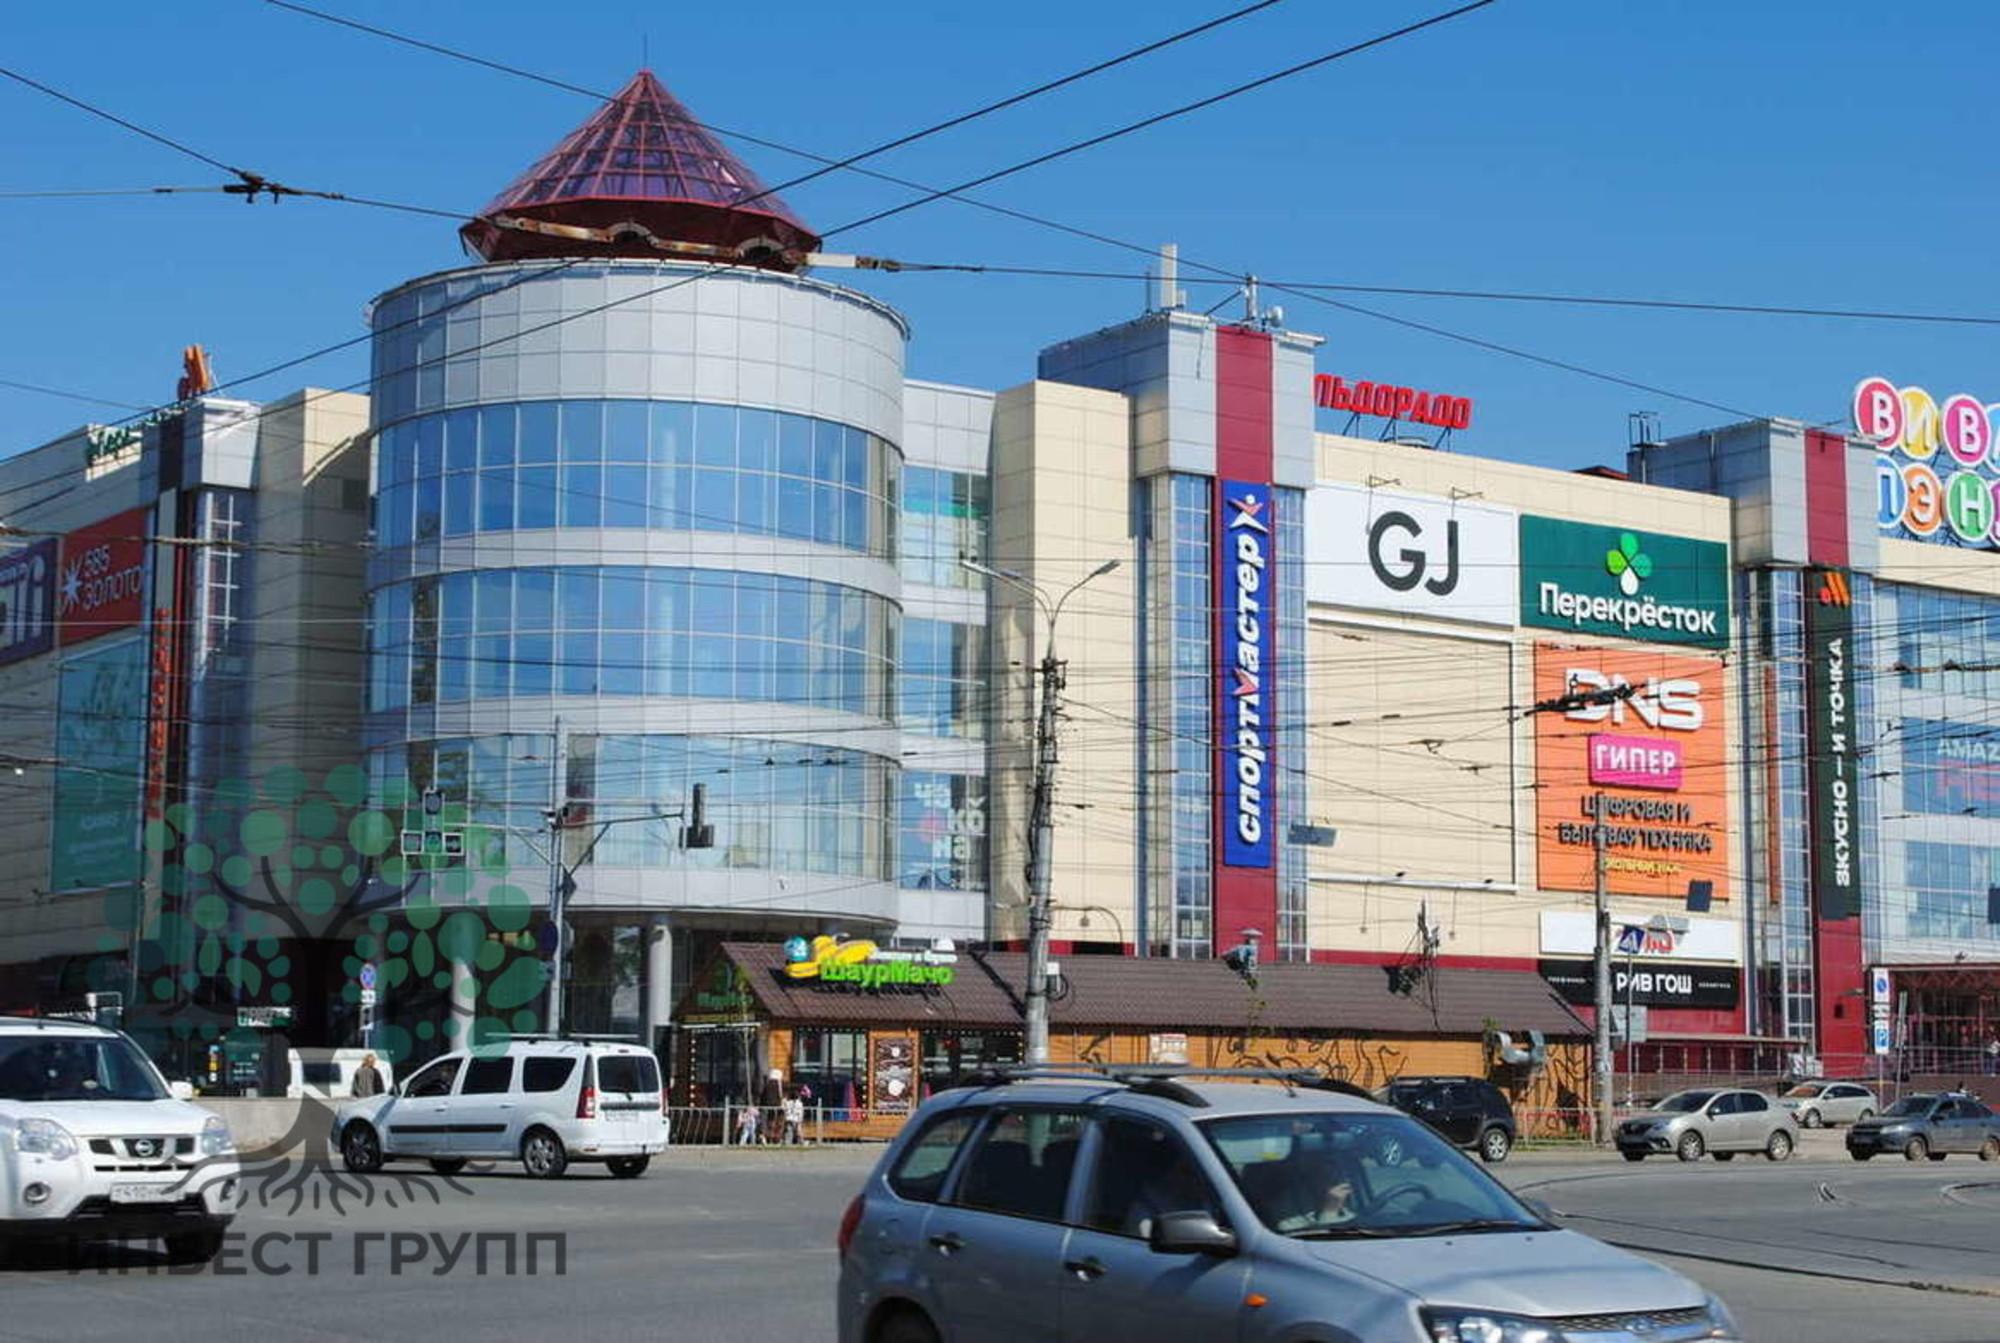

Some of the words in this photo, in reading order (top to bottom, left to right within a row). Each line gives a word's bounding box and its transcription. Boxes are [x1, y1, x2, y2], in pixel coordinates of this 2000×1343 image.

[84, 545, 111, 576] 585
[1368, 511, 1458, 596] GJ
[1540, 581, 1717, 635] Перекрёсток
[1829, 637, 1846, 727] ТОЧКА
[1565, 668, 1704, 731] DNS
[1832, 733, 1846, 752] И
[1595, 744, 1676, 775] ГИПЕР
[1580, 795, 1673, 824] ЦФРОВАЯ
[1558, 821, 1639, 850] БЫТВАЯ
[1833, 780, 1850, 888] ВКУСНО
[1616, 972, 1653, 992] РИВ
[1656, 973, 1692, 994] ГОШ
